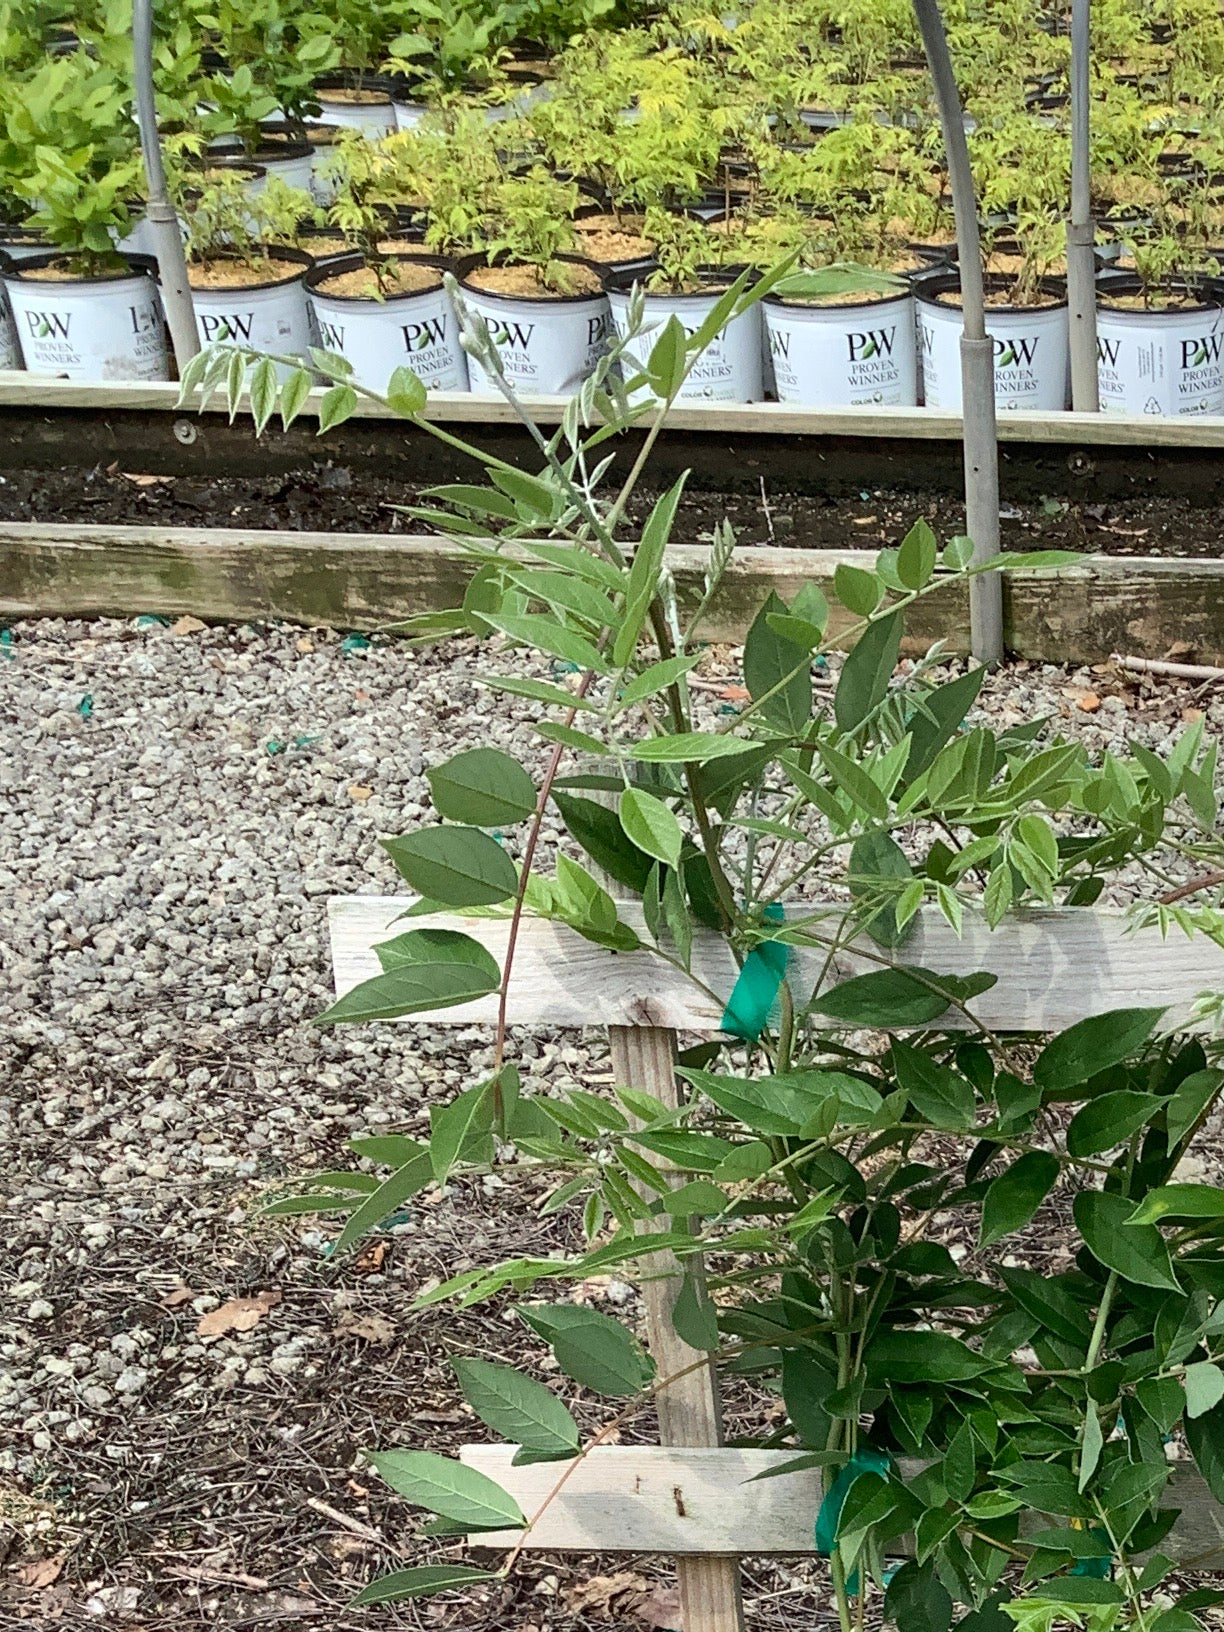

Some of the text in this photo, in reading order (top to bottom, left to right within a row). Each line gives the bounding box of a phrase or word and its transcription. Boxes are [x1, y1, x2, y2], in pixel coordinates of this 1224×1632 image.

[25, 310, 72, 339] PW
[199, 313, 254, 342] PW
[400, 314, 447, 352] PW
[34, 342, 74, 352] PROVEN
[771, 329, 791, 359] W
[846, 326, 897, 362] PW
[1180, 332, 1224, 369] PW
[409, 345, 449, 364] PROVEN
[500, 351, 530, 362] OVEN
[506, 364, 536, 374] NERS
[689, 366, 731, 379] INNERS
[851, 359, 895, 375] PROVEN
[995, 369, 1034, 381] ROVEN
[1183, 366, 1221, 382] PROVEN
[847, 371, 898, 386] WINNERS
[995, 381, 1037, 392] INNERS
[1179, 377, 1223, 394] WINNERS
